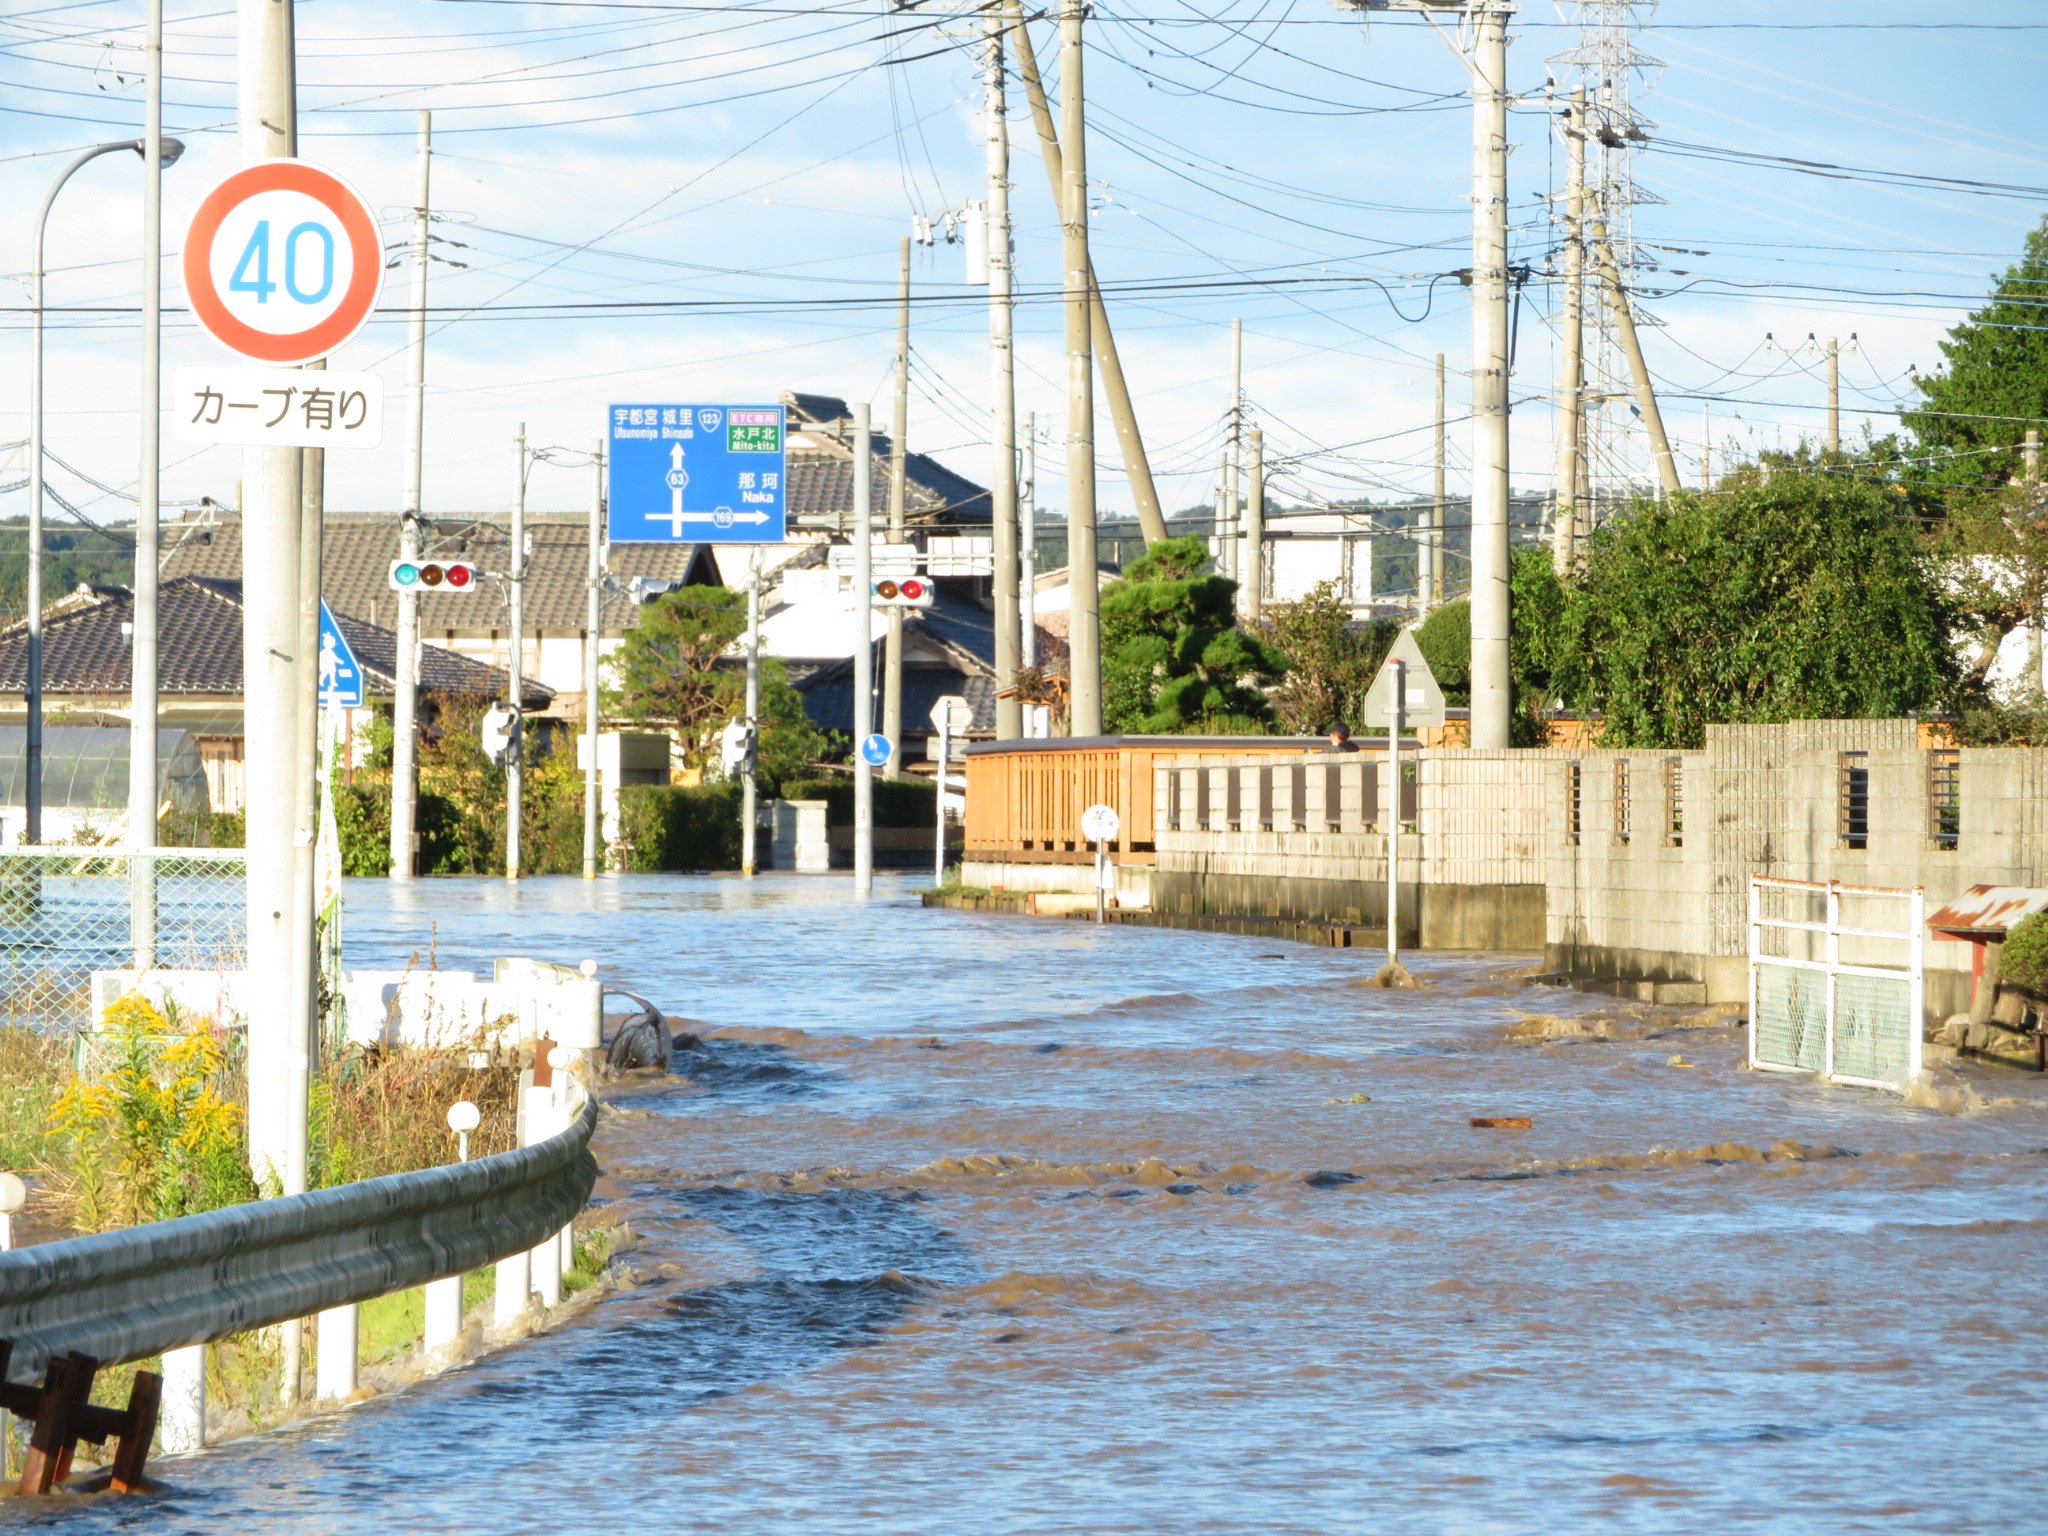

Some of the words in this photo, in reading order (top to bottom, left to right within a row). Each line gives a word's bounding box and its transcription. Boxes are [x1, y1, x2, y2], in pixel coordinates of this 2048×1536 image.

[229, 220, 334, 305] 40
[192, 385, 367, 430] カーブ有り
[614, 408, 658, 426] 宇都宮
[662, 408, 693, 426] 城里
[702, 413, 718, 425] 123
[732, 427, 775, 440] 水戸北
[732, 441, 775, 451] Mito-kita
[670, 473, 684, 486] 63
[738, 472, 779, 489] 那珂
[742, 491, 774, 503] Naka
[716, 512, 732, 523] 169
